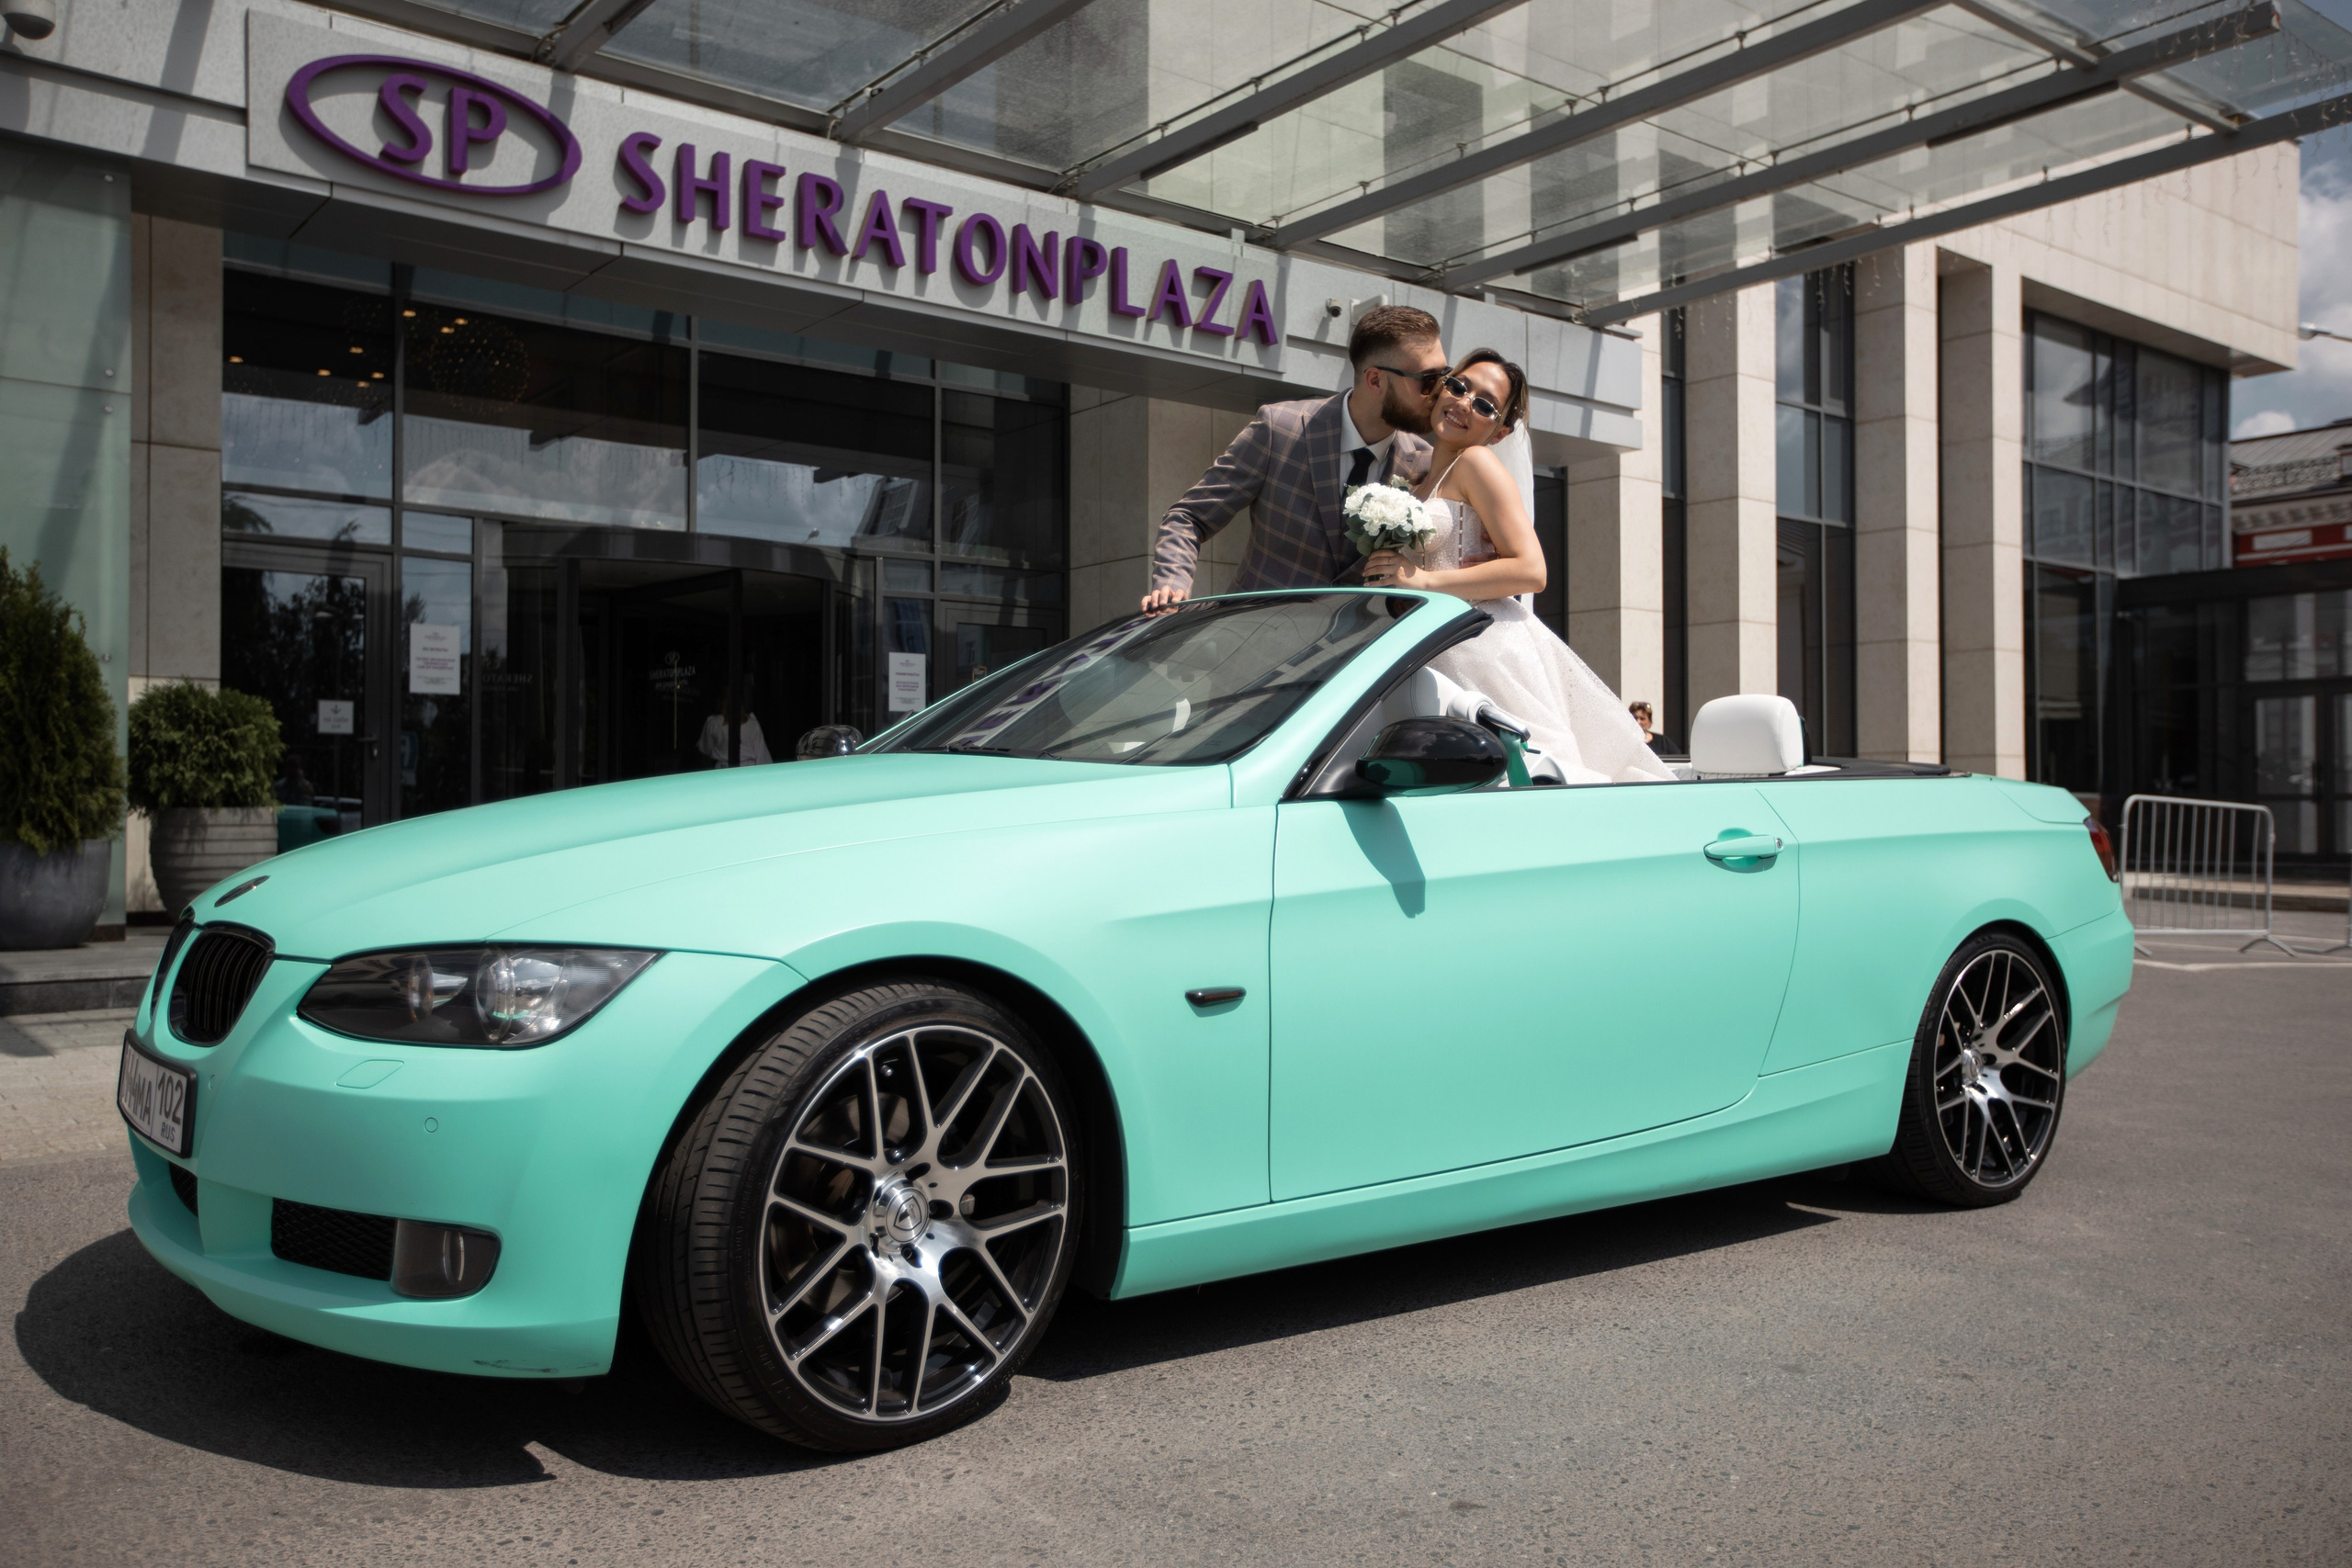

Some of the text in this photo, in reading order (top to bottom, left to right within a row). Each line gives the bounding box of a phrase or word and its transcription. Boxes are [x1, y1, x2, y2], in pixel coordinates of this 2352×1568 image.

[379, 73, 508, 175] SP
[619, 131, 1279, 346] SHERATONPLAZA
[158, 1071, 183, 1125] 102
[161, 1122, 175, 1142] RUS
